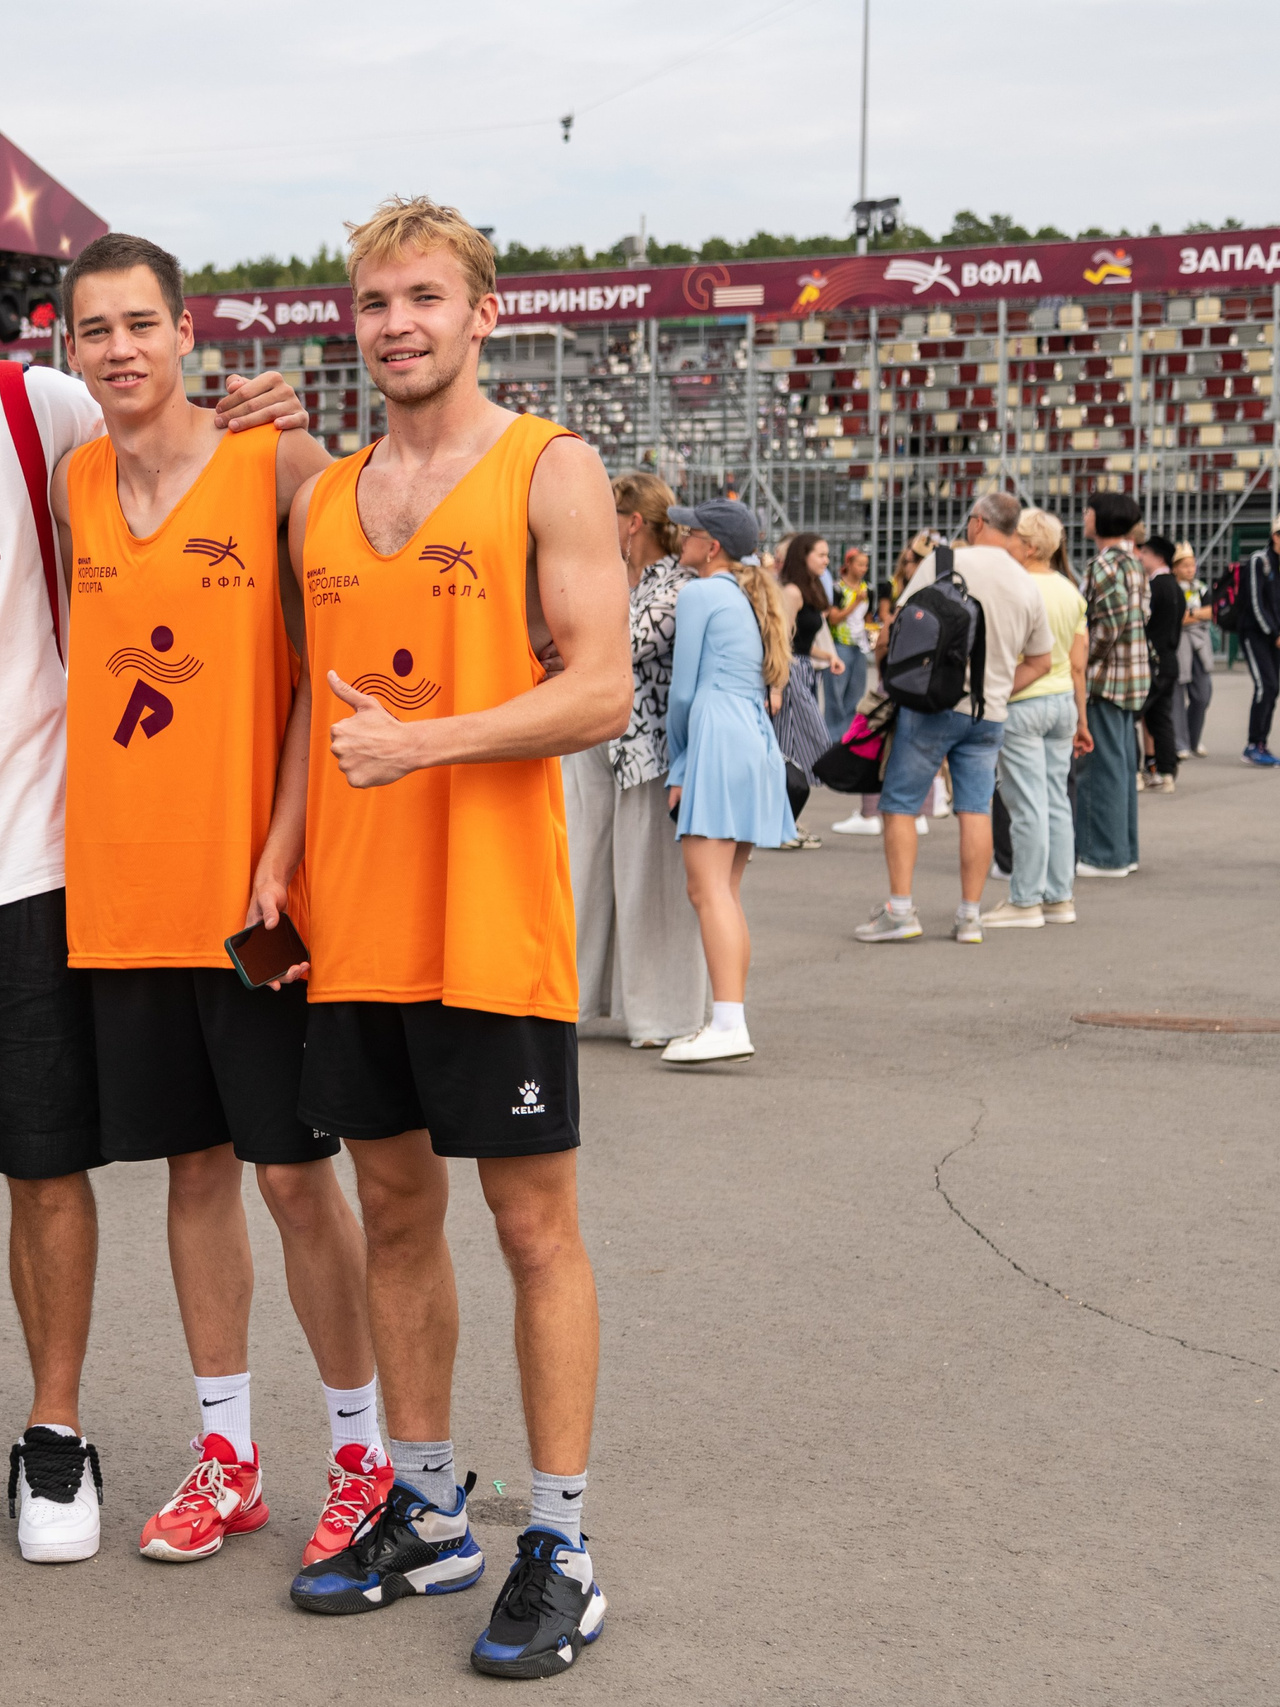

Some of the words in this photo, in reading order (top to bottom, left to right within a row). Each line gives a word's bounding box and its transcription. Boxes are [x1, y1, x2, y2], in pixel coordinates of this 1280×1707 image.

[1178, 242, 1280, 274] ЗАПАД
[961, 259, 1042, 287] ВФЛА
[496, 283, 652, 315] АТЕРИНБУРГ
[275, 300, 340, 325] ВФЛА
[78, 566, 118, 578] КОРОЛЕВА
[511, 1104, 546, 1115] KELME
